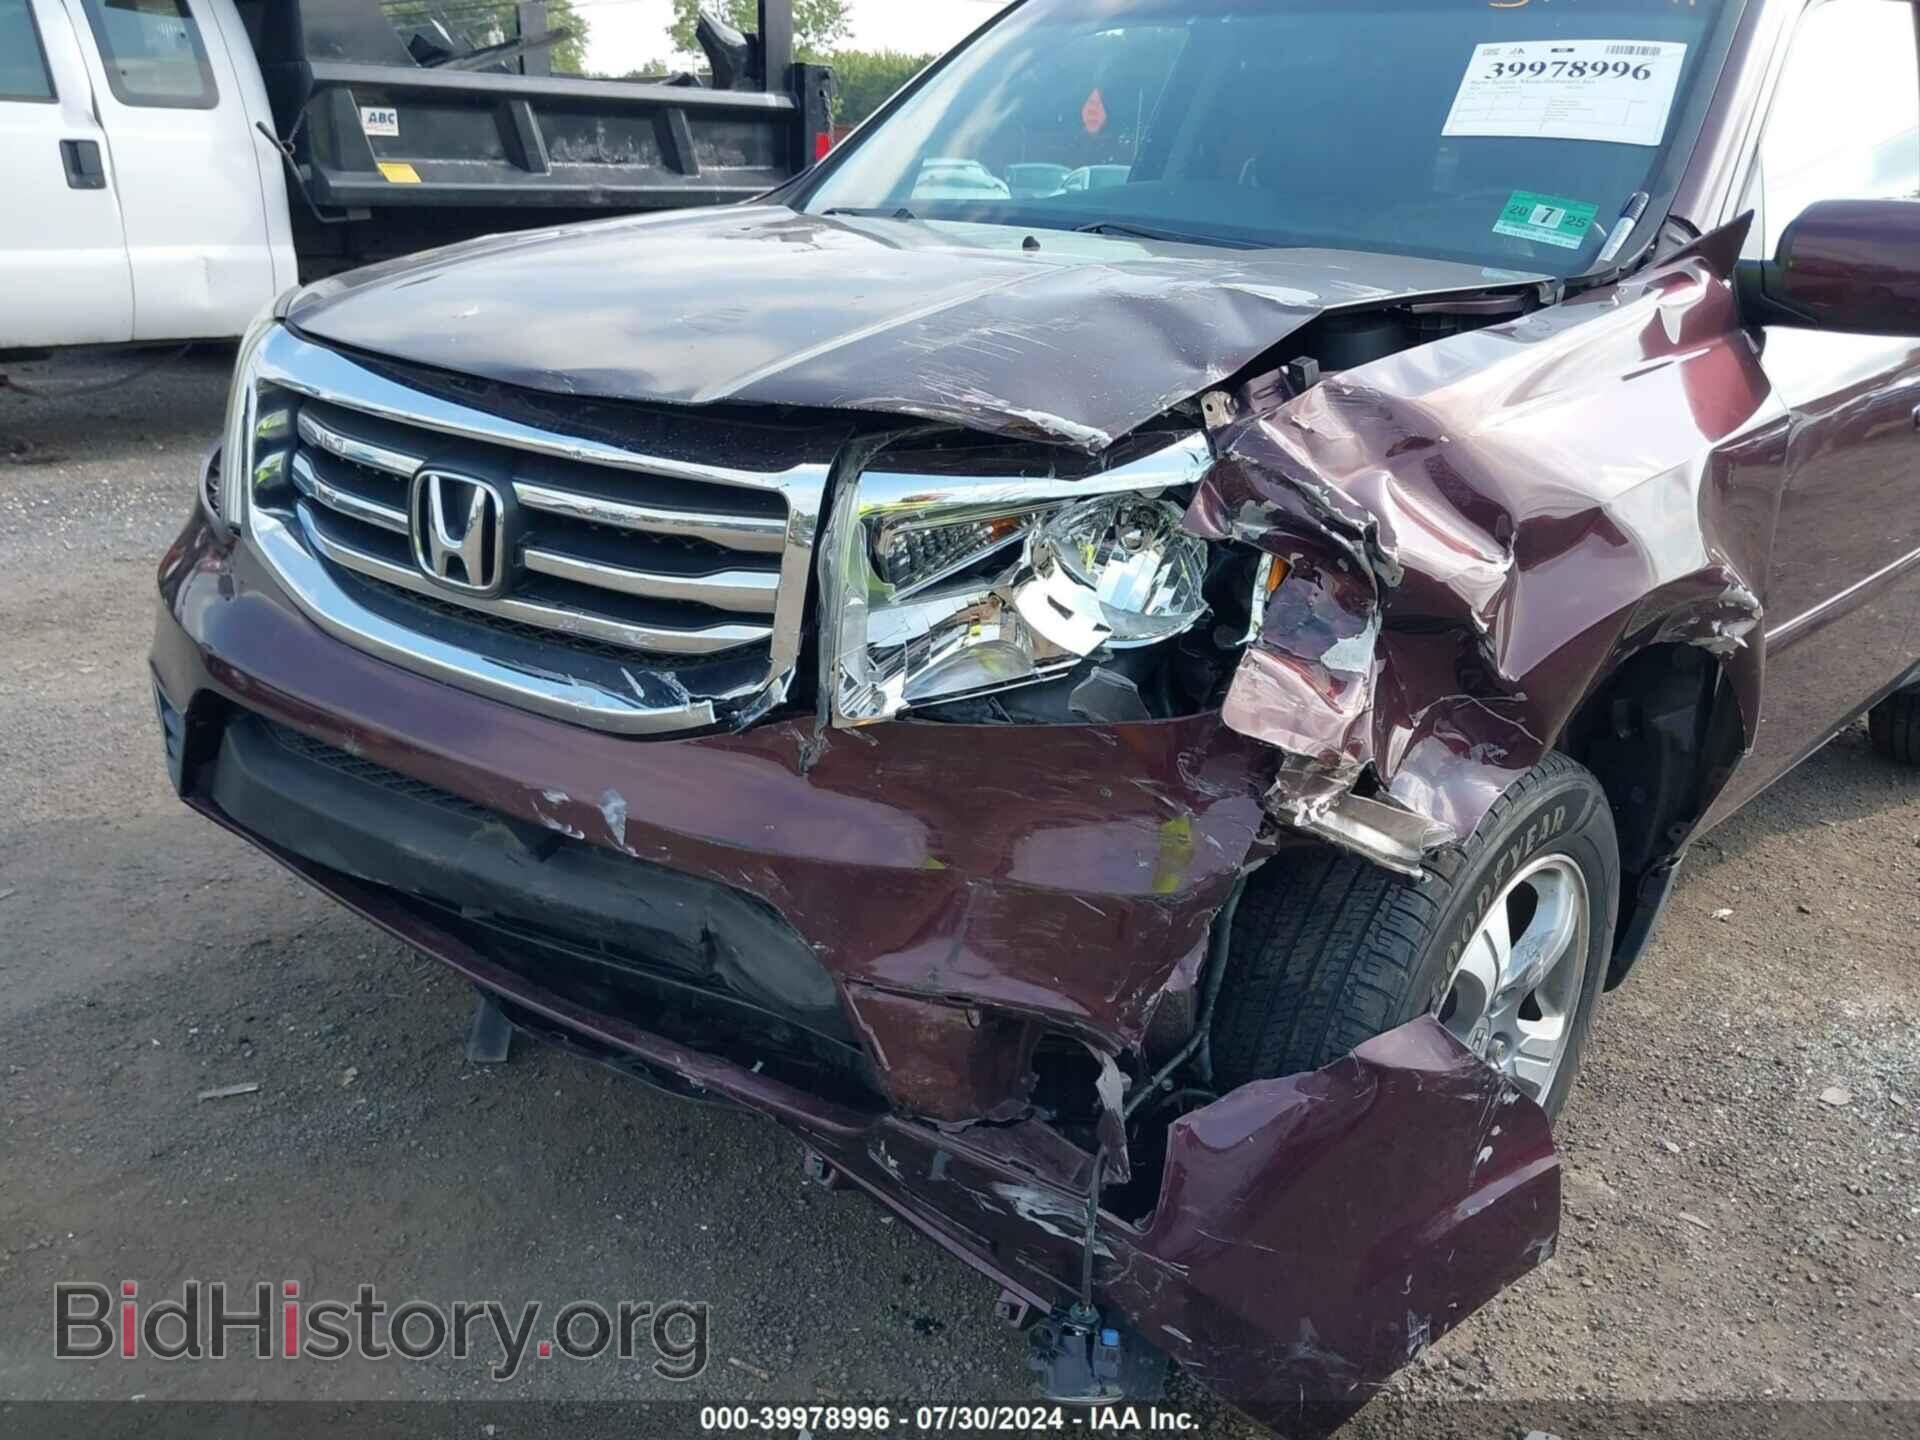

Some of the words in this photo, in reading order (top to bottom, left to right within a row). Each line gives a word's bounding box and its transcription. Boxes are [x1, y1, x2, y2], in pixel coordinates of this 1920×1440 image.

[1484, 61, 1652, 80] 39978996
[369, 111, 395, 125] ABC
[1509, 204, 1528, 217] 20
[1540, 207, 1555, 223] 7
